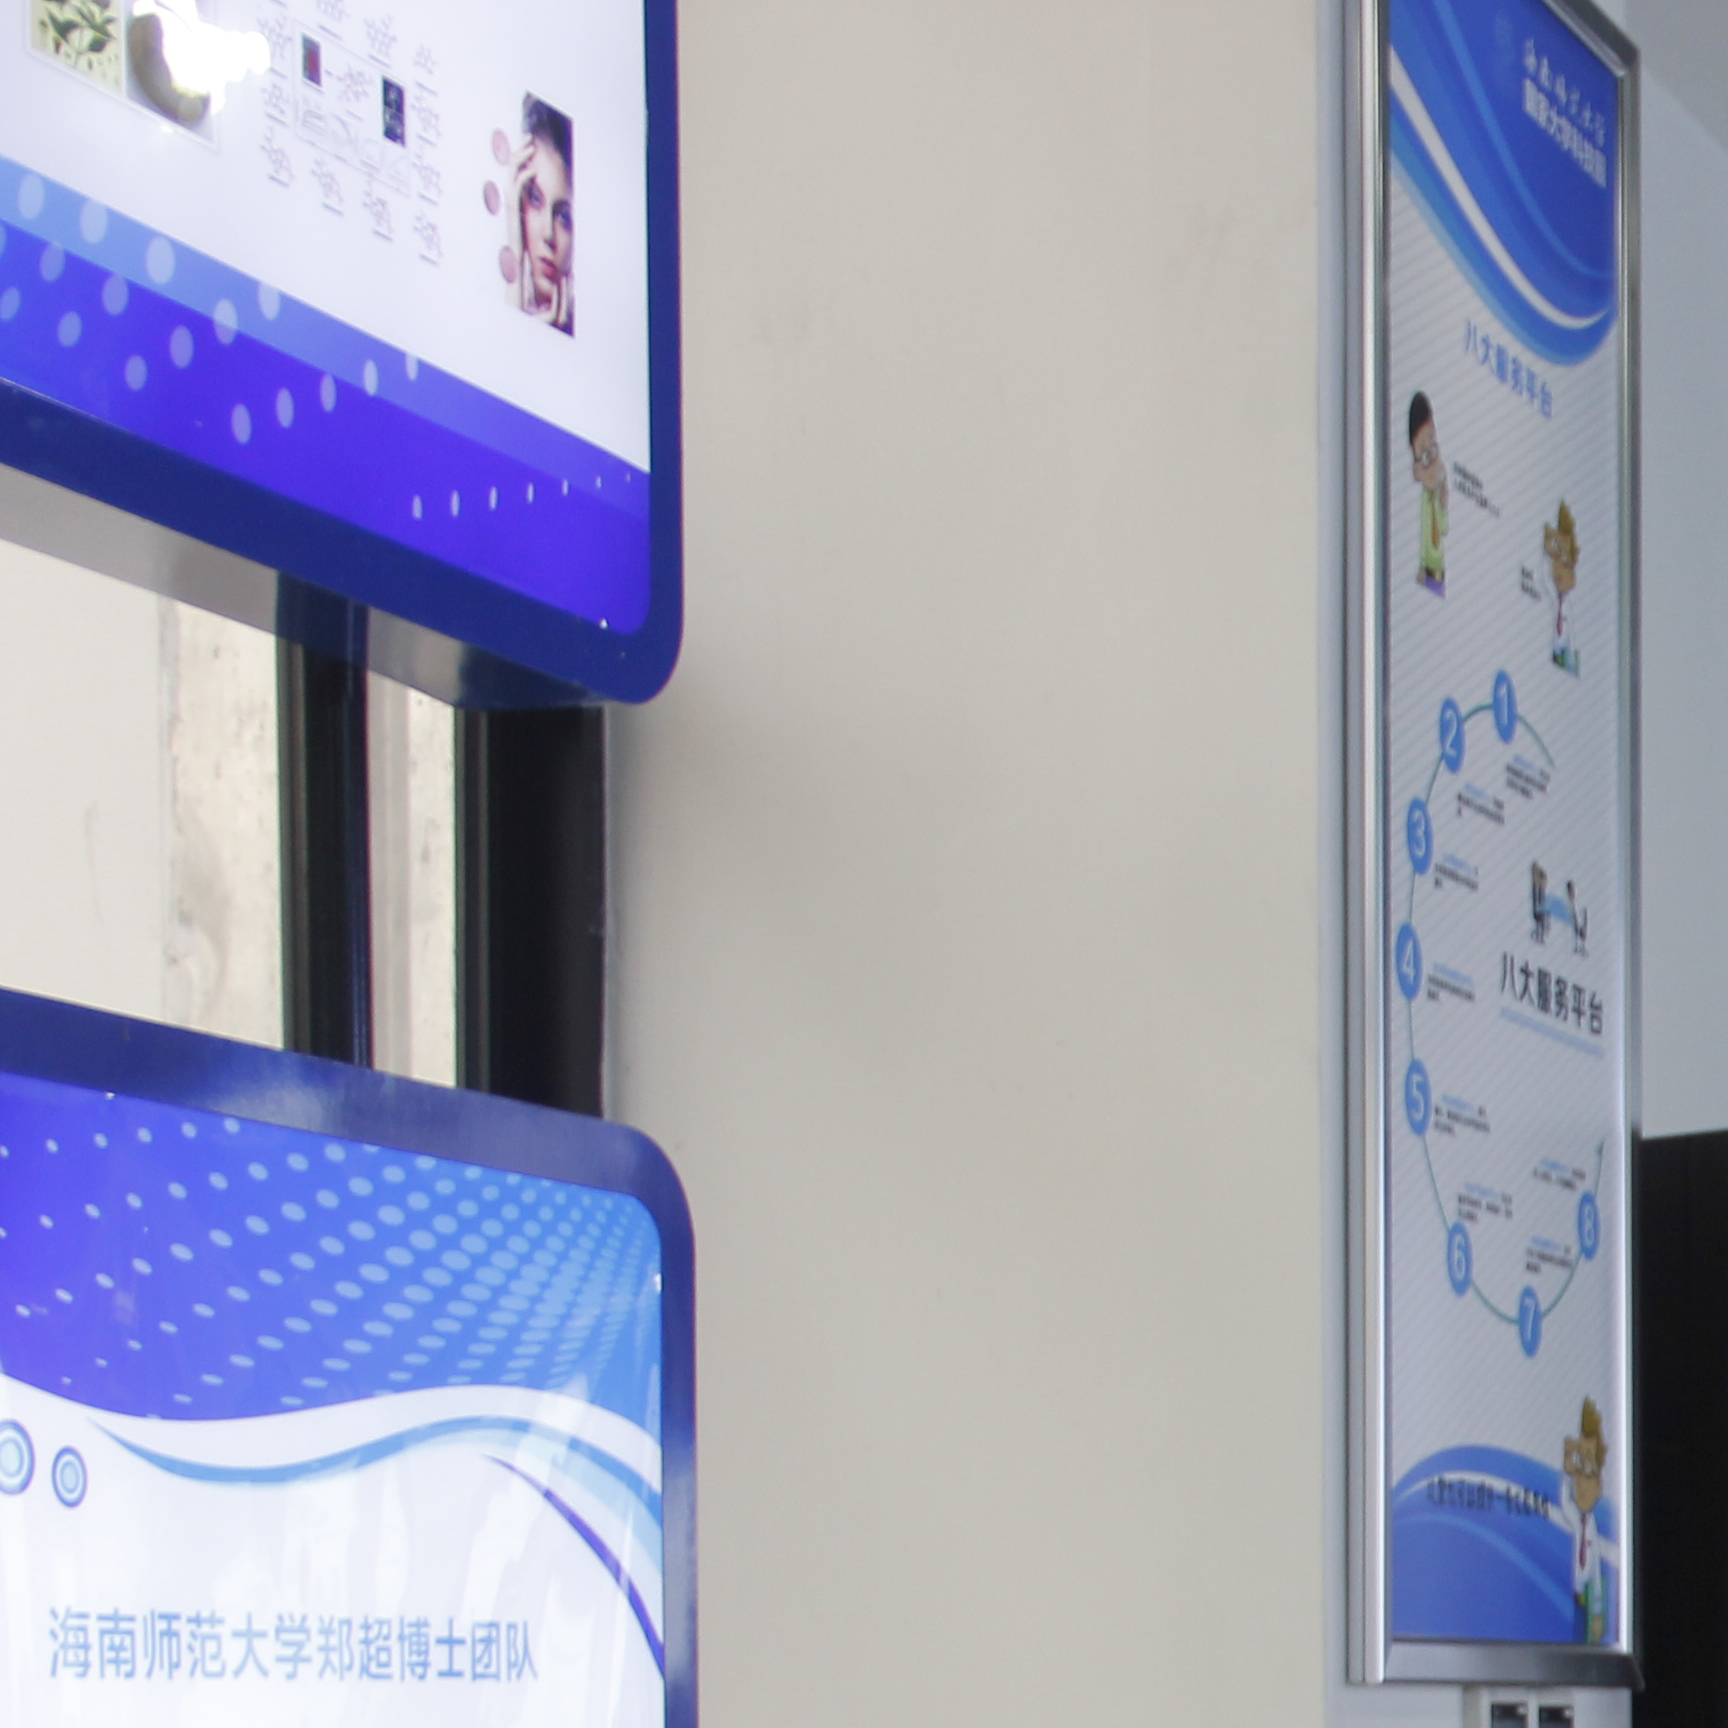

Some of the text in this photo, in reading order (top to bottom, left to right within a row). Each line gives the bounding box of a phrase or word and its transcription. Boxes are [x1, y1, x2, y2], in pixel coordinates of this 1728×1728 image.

[1443, 711, 1458, 756] 2
[1411, 810, 1426, 858] 3
[1402, 943, 1416, 984] 4
[1500, 950, 1604, 1035] 八大服务平台
[1411, 1072, 1425, 1122] 5
[1452, 1236, 1466, 1281] 6
[49, 1606, 539, 1684] 海南师范大学郑超博士团队
